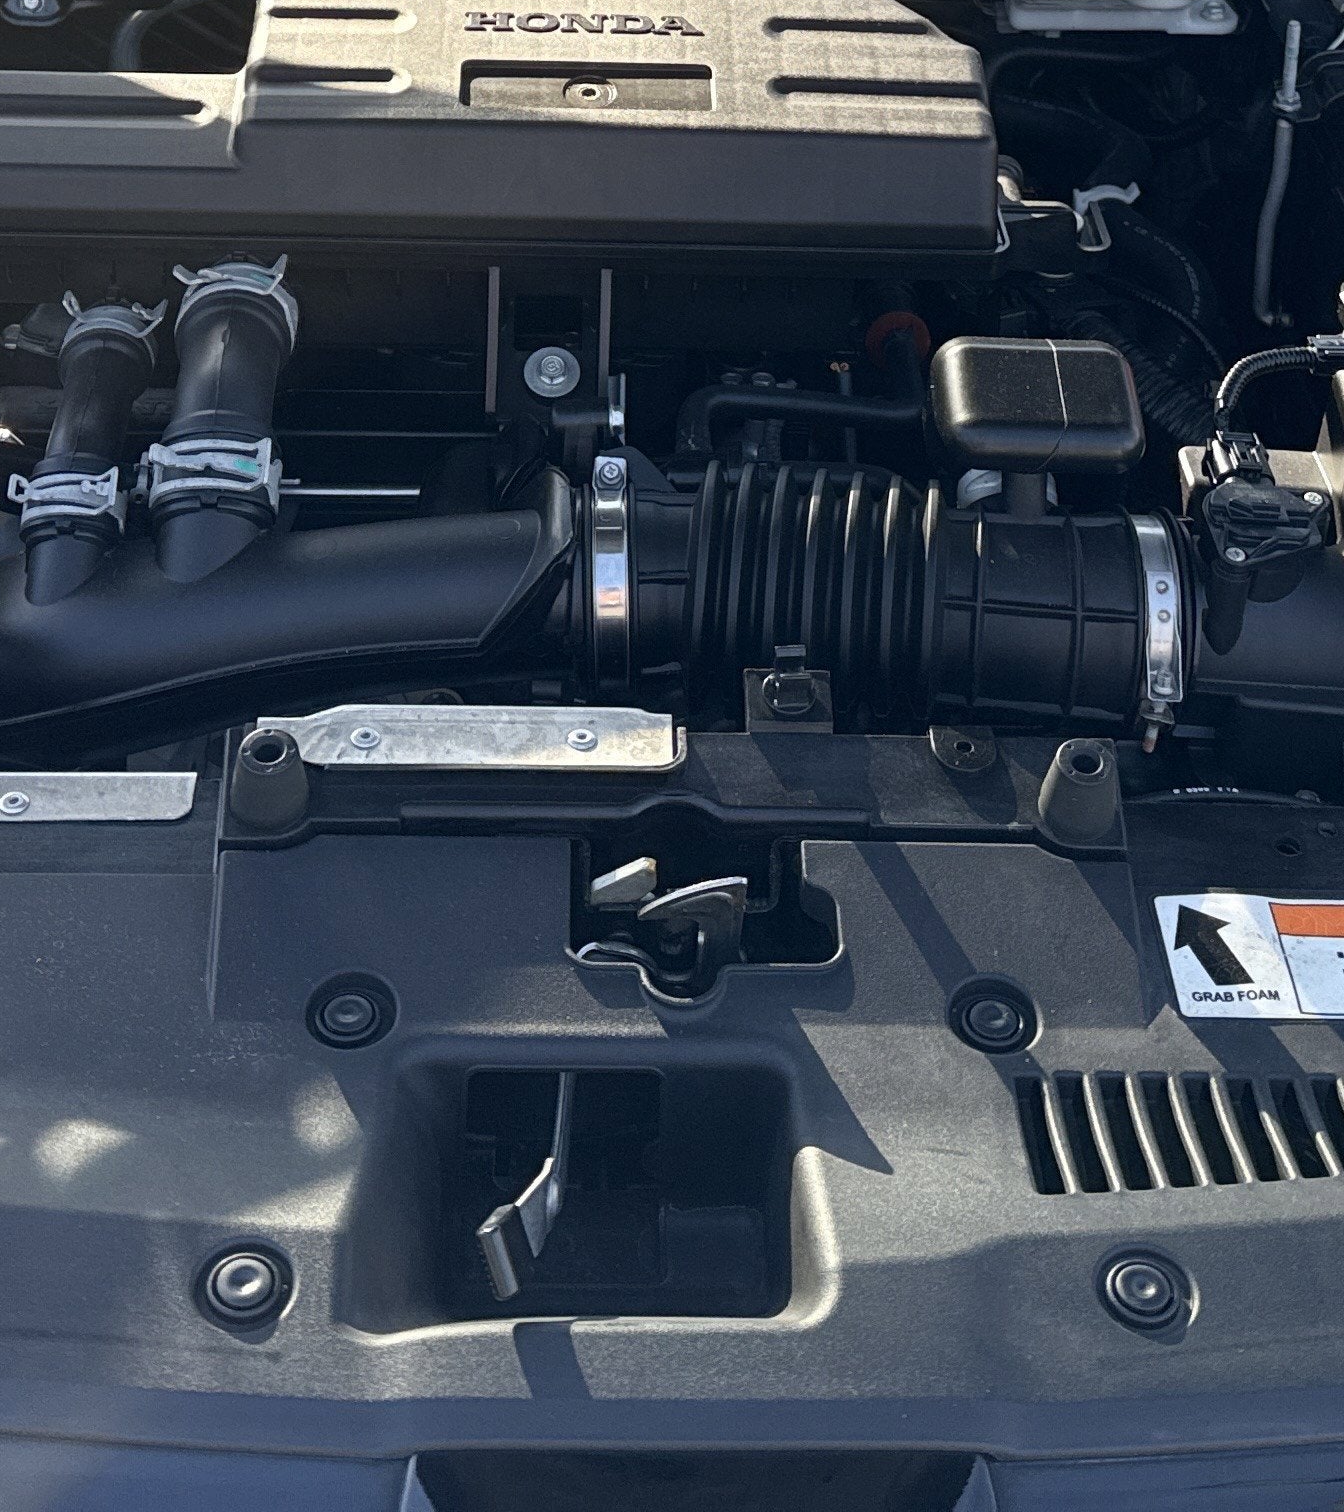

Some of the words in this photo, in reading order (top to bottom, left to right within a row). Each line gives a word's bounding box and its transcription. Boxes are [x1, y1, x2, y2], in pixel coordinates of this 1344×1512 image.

[463, 11, 706, 37] HONDA
[1191, 991, 1235, 1003] GRAB
[1236, 989, 1281, 1002] FOAM
